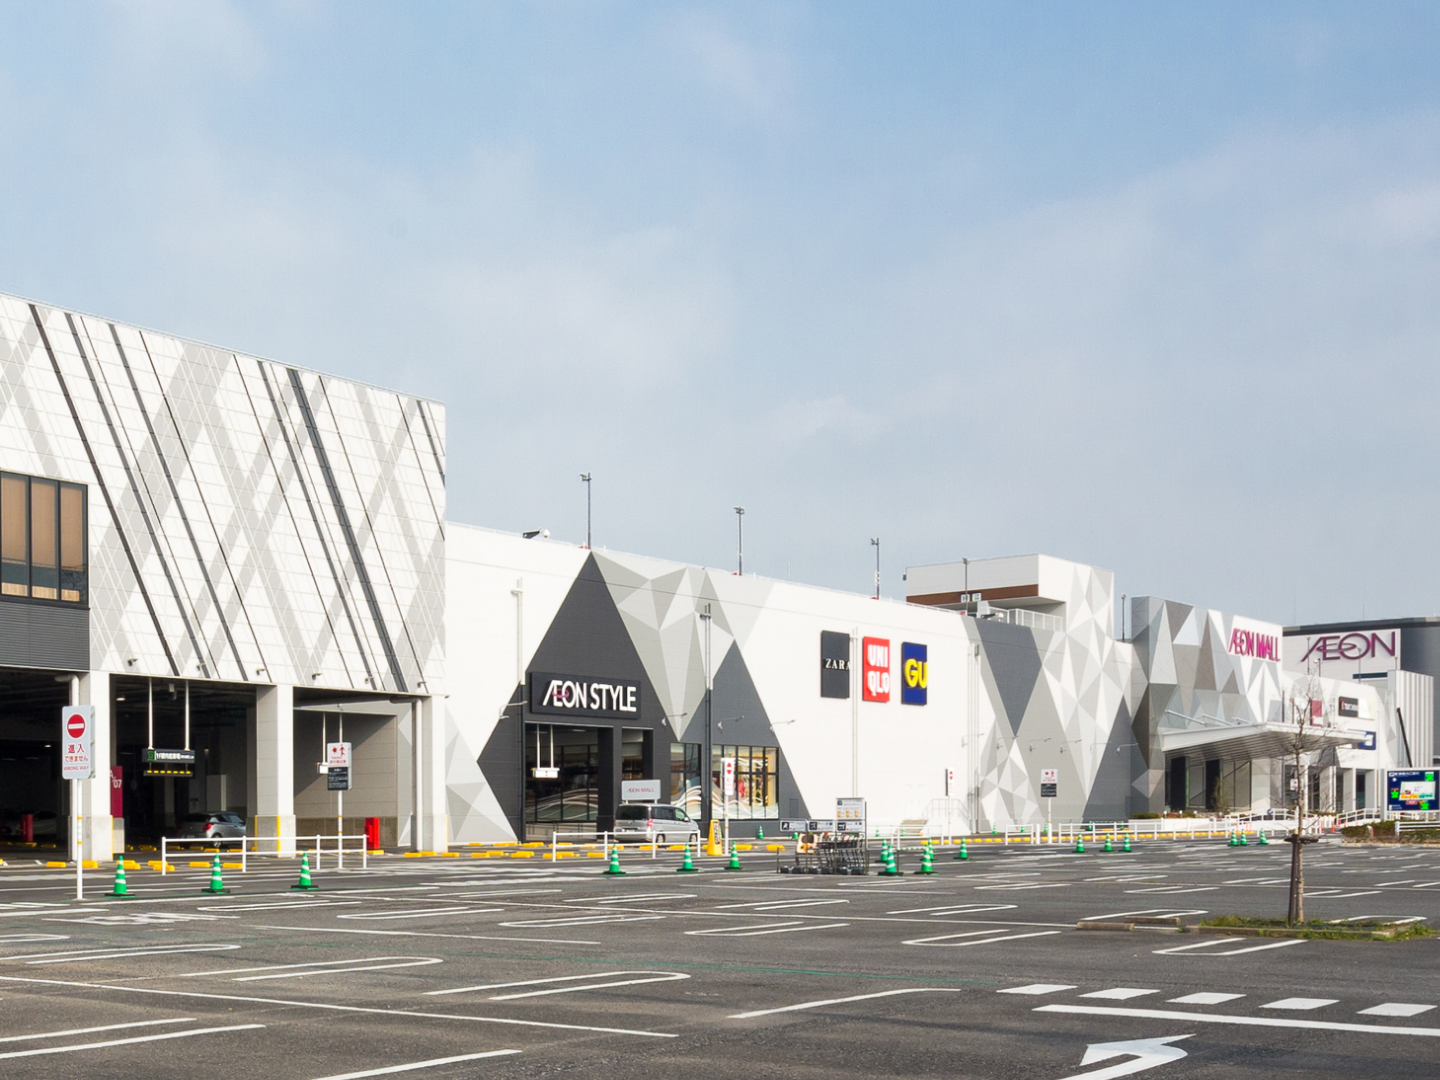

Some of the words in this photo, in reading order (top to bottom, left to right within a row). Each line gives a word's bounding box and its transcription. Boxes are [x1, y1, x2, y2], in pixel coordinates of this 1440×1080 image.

[867, 644, 888, 668] UNI
[1256, 634, 1280, 662] MALL
[825, 658, 850, 670] ZARA
[905, 658, 928, 688] GU
[867, 670, 890, 697] QLO
[590, 683, 637, 712] STYLE
